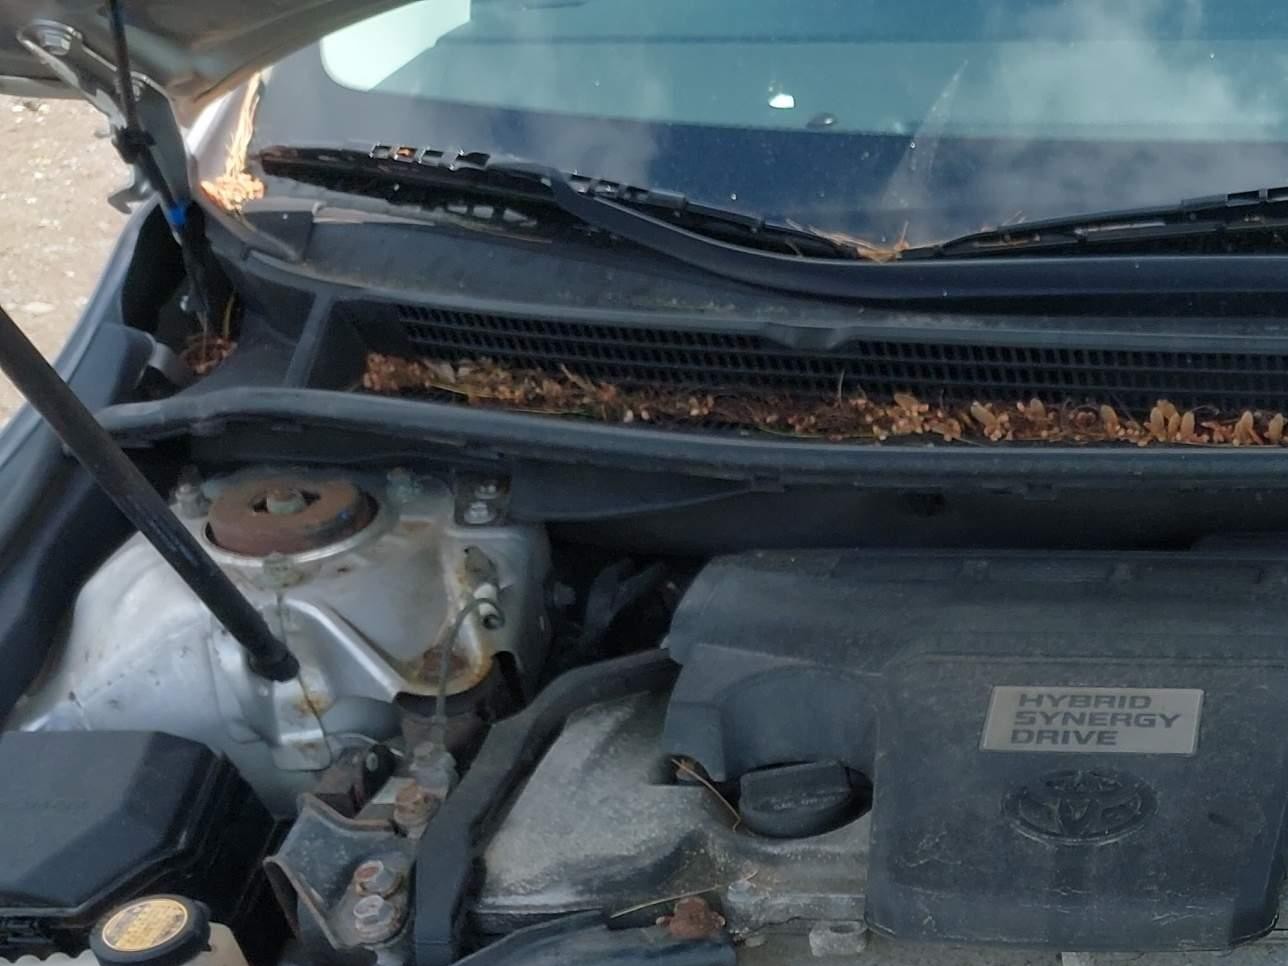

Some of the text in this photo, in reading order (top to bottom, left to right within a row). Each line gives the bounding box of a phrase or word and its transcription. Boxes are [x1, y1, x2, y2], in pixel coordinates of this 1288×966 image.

[1018, 693, 1153, 709] HYBRID
[1014, 711, 1181, 728] SYNERGY
[1010, 729, 1119, 746] DRIVE
